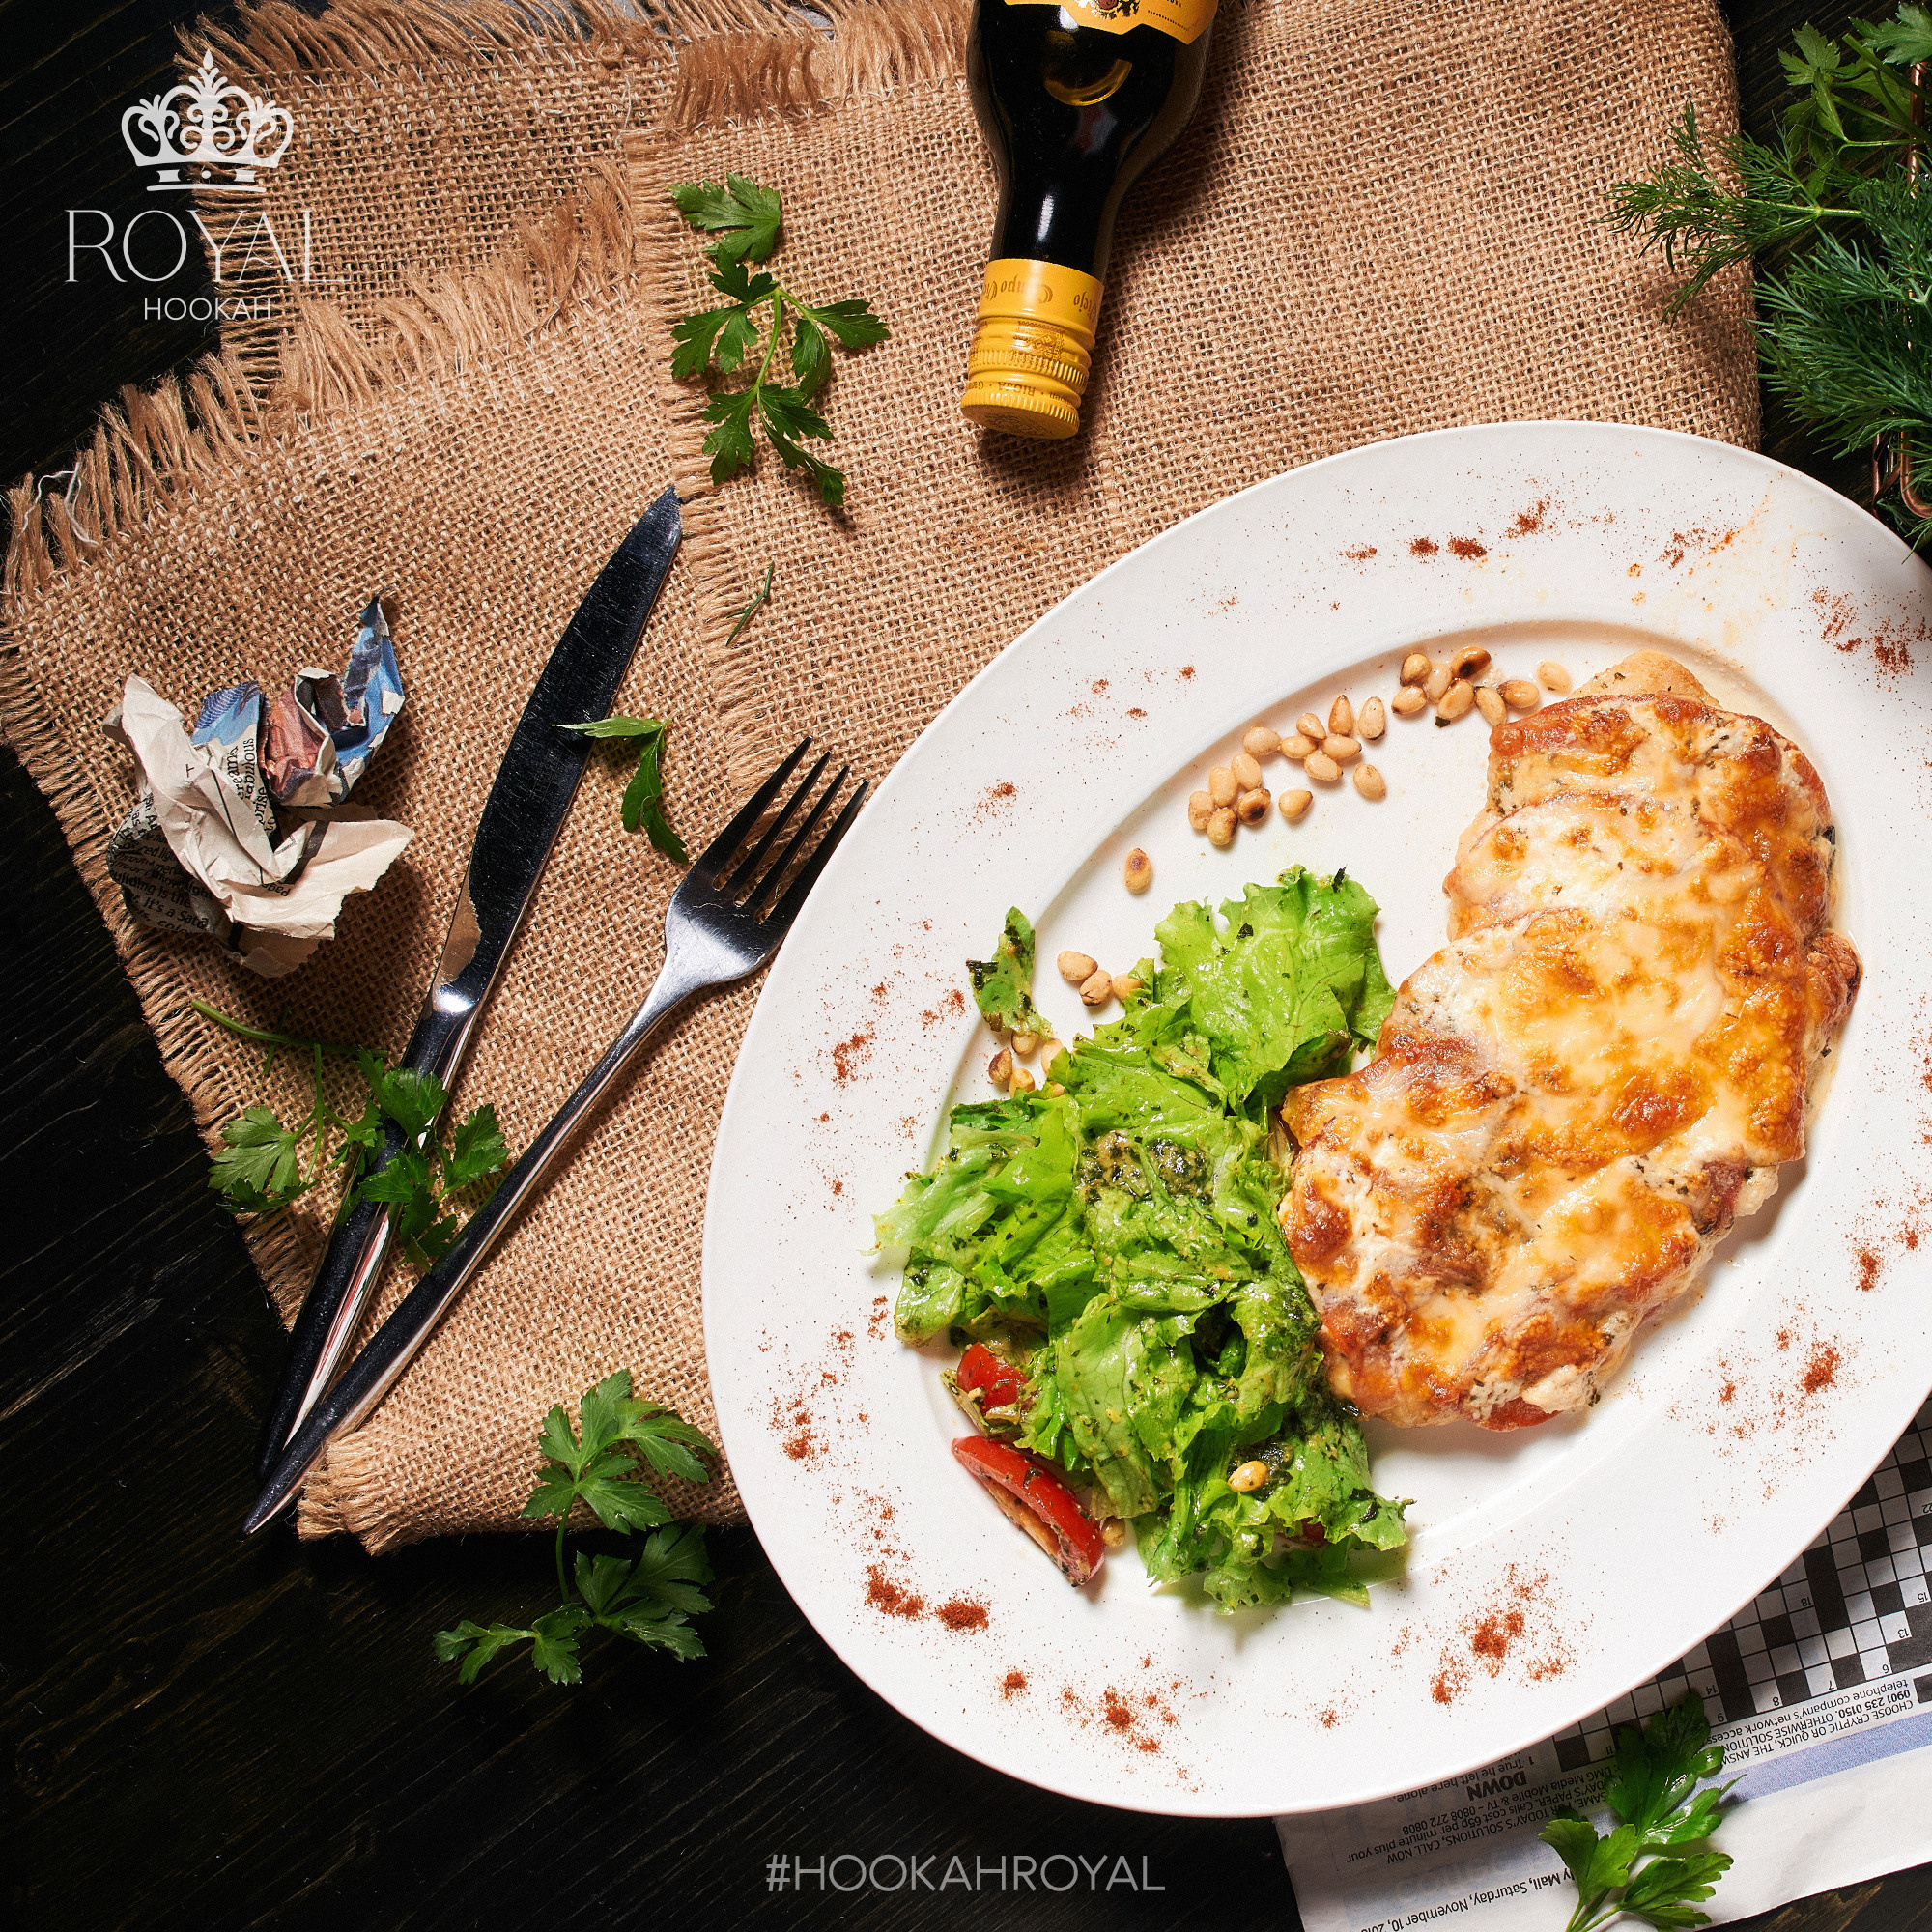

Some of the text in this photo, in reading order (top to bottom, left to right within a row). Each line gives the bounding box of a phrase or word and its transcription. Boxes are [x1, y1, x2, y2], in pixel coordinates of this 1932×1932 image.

[166, 908, 175, 918] a
[1801, 1596, 1812, 1607] 18
[1917, 1592, 1929, 1604] 15
[1897, 1628, 1910, 1639] 13
[1882, 1663, 1889, 1674] 6
[1705, 1684, 1718, 1695] 14
[1828, 1680, 1834, 1690] 7
[1852, 1679, 1908, 1700] telephone
[1772, 1696, 1780, 1707] 8
[1864, 1696, 1885, 1710] 235
[1887, 1689, 1910, 1704] 0901
[1793, 1695, 1850, 1719] company's
[1834, 1704, 1862, 1718] 0150.
[1871, 1700, 1913, 1719] CHOOSE
[1717, 1713, 1725, 1722] 9
[1744, 1714, 1791, 1734] network
[1828, 1713, 1870, 1733] CRYPTIC
[1774, 1713, 1833, 1739] OTHERWISE
[1810, 1726, 1826, 1738] OR
[1706, 1727, 1742, 1748] access
[1774, 1731, 1809, 1748] QUICK,
[1605, 1746, 1614, 1756] 11
[1719, 1748, 1749, 1765] ANSW
[1752, 1743, 1774, 1756] THE
[1497, 1758, 1524, 1772] True
[1528, 1756, 1534, 1765] 1
[1459, 1772, 1480, 1785] left
[1481, 1766, 1496, 1777] he
[1586, 1766, 1612, 1781] DMG
[1430, 1777, 1459, 1792] here
[1466, 1770, 1527, 1801] DOWN
[1549, 1774, 1584, 1790] Media
[1511, 1784, 1548, 1802] Mobile
[1534, 1787, 1572, 1806] PAPER.
[1487, 1799, 1499, 1810] TV
[1506, 1797, 1533, 1814] Calls
[1429, 1813, 1449, 1828] 272
[1450, 1805, 1476, 1822] 0808
[1460, 1814, 1482, 1828] 65p
[1482, 1806, 1506, 1823] cost
[1505, 1808, 1549, 1829] TODAY'S
[1402, 1820, 1428, 1835] 0808
[1439, 1819, 1459, 1834] per
[1441, 1820, 1503, 1846] SOLUTIONS,
[1398, 1828, 1437, 1846] minute
[1346, 1846, 1373, 1862] your
[1375, 1838, 1396, 1855] plus
[1413, 1839, 1440, 1854] CALL
[1387, 1847, 1413, 1864] NOW
[1529, 1872, 1561, 1891] Mail,
[1469, 1882, 1528, 1906] Saturday,
[1405, 1898, 1469, 1927] November
[1387, 1918, 1405, 1932] 10,
